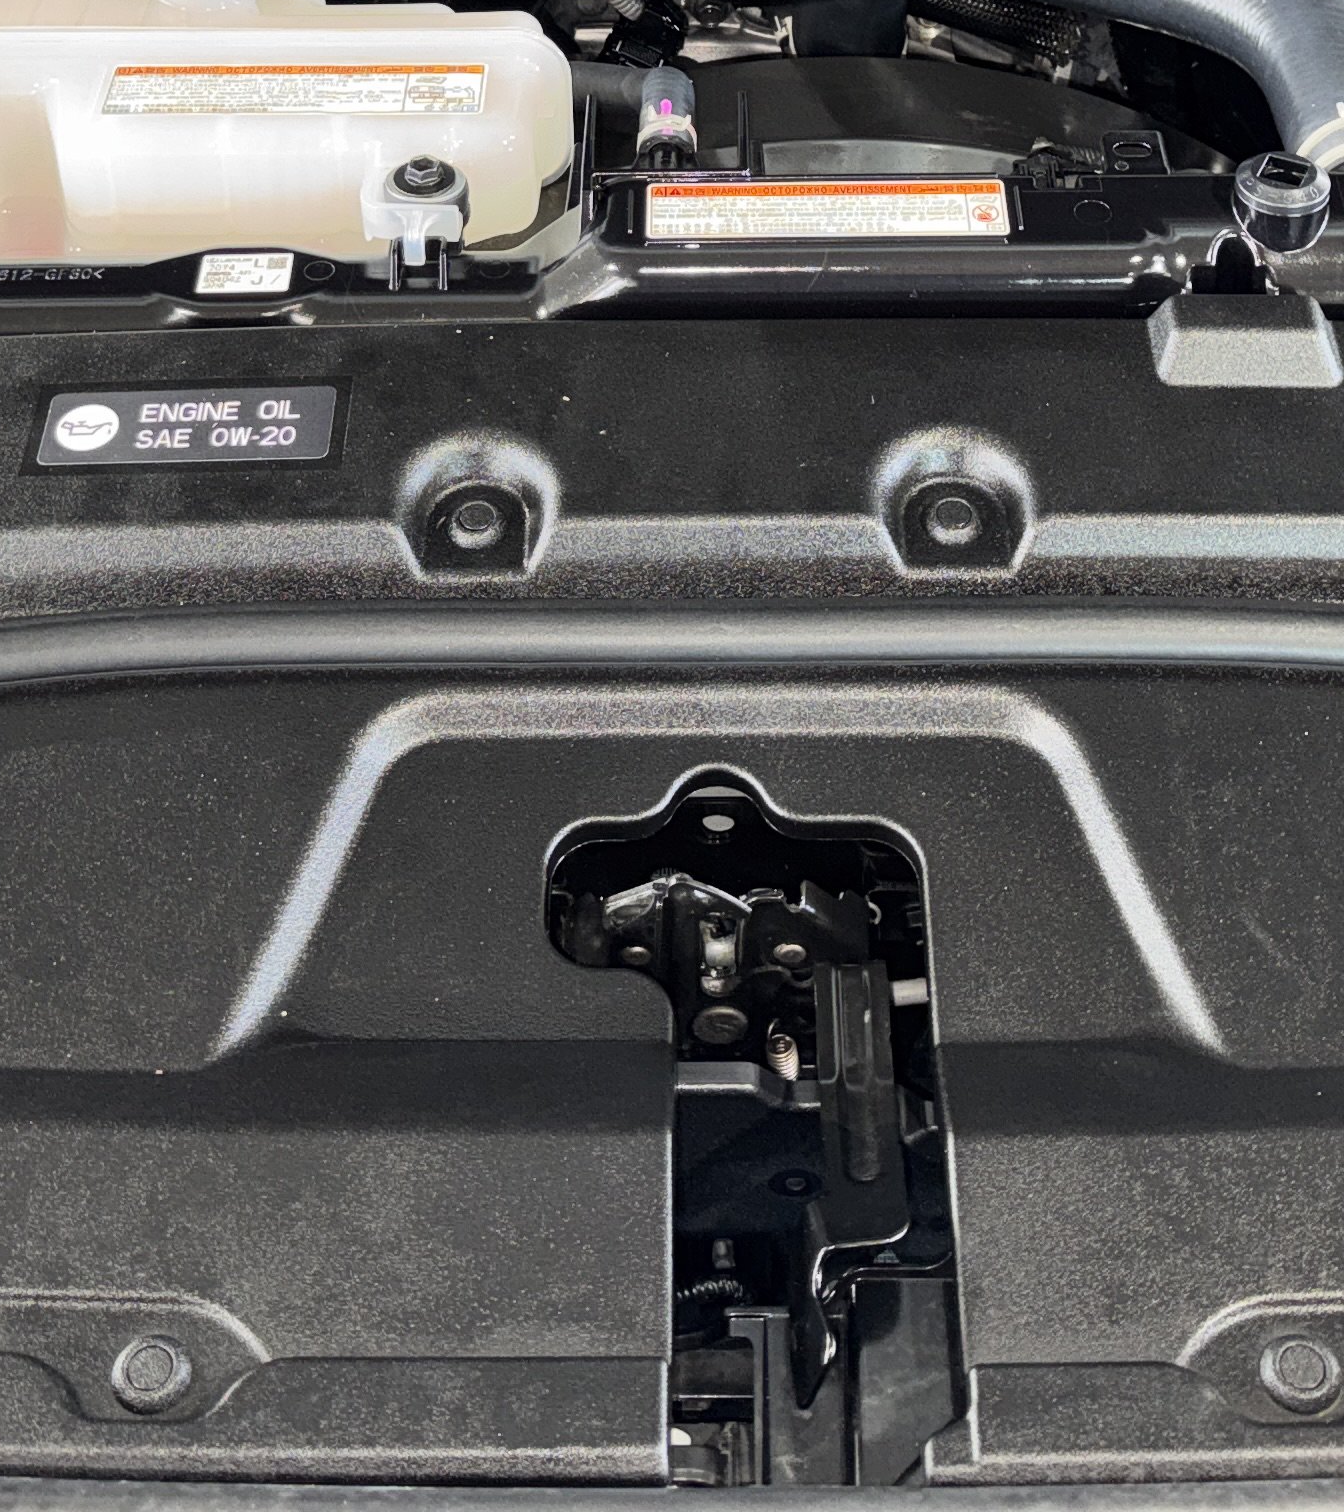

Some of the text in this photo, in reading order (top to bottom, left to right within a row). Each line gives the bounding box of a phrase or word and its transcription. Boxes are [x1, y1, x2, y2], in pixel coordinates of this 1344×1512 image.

[711, 187, 758, 196] WARNING
[763, 186, 827, 195] ОСТОРОЖНО
[834, 185, 912, 194] AVERTISSEMENT
[138, 399, 301, 423] ENGINE OIL
[134, 425, 297, 449] SAE 0W-20
